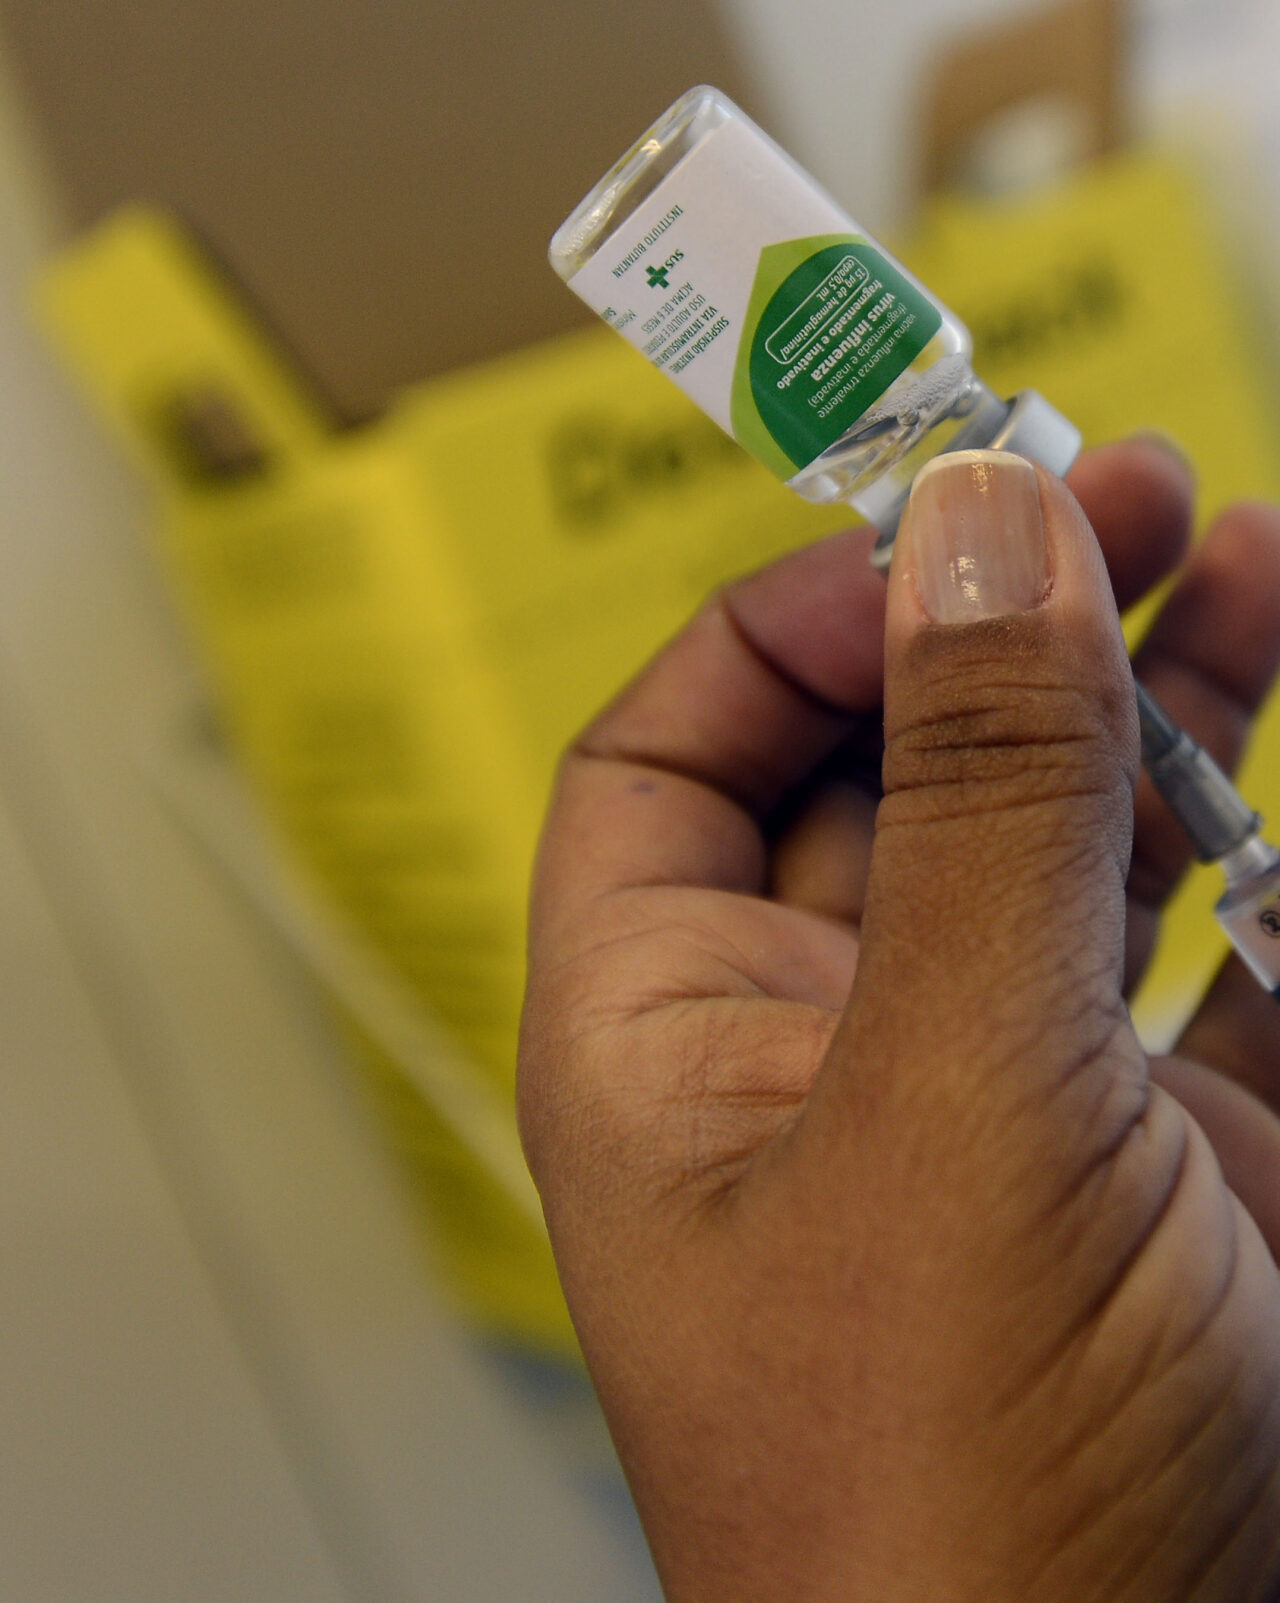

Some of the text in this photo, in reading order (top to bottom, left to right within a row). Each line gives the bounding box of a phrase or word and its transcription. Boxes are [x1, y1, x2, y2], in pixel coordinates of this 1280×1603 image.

[611, 203, 684, 279] INSTITUTO BUTANTAN
[664, 250, 684, 269] SUS
[853, 267, 866, 280] 15
[642, 280, 694, 335] ACIMA DE 6 MESES
[687, 293, 706, 312] USO
[815, 285, 830, 302] mL
[835, 285, 848, 299] de
[665, 307, 692, 333] ADULTO
[699, 305, 718, 321] VIA
[778, 295, 840, 361] hemaglutinina/
[661, 327, 670, 337] E
[690, 315, 730, 354] SUSPENSÃO
[775, 278, 883, 390] fragmentado e inativado
[809, 291, 896, 382] vírus influenza
[806, 300, 908, 408] (fragmentada e inativada)
[815, 312, 917, 418] vacina influenza trivalente
